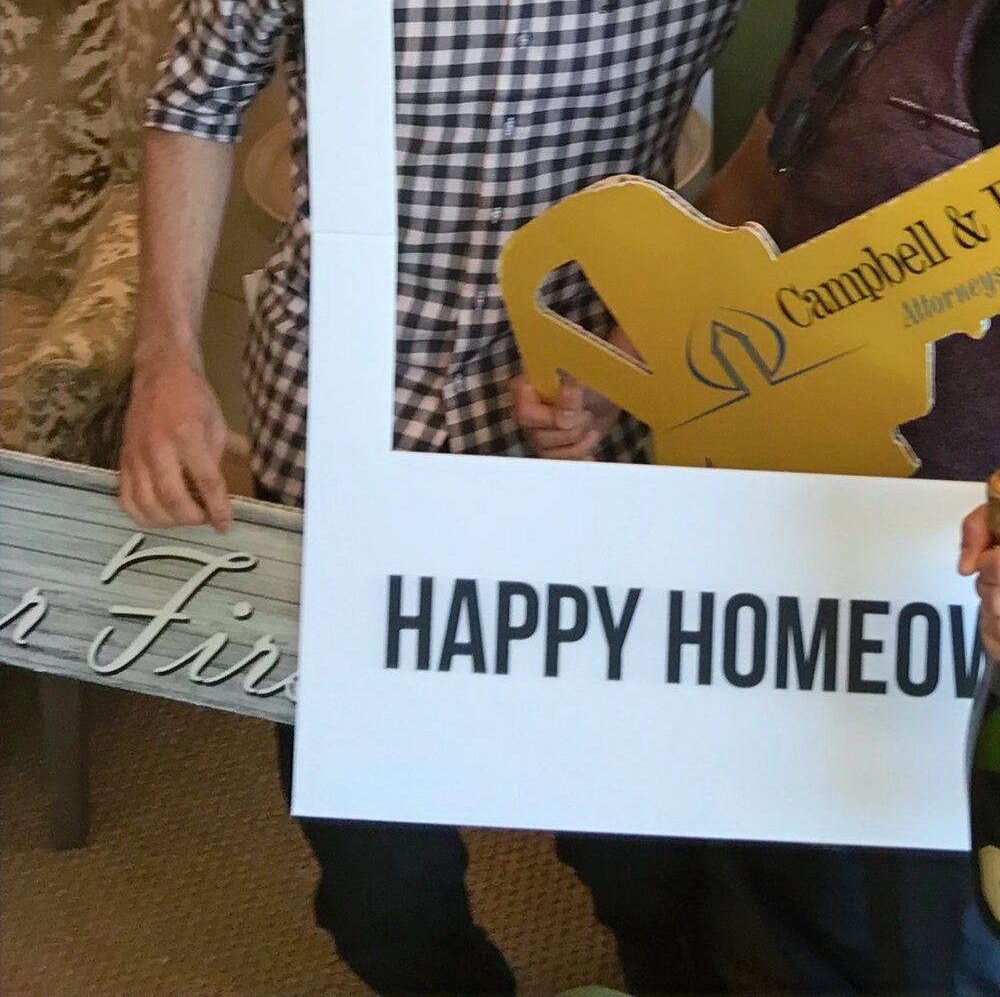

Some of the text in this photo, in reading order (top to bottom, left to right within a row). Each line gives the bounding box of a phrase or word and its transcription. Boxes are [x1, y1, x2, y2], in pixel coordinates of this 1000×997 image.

[776, 220, 951, 328] Campbell
[944, 206, 990, 249] &
[386, 575, 642, 681] HAPPY
